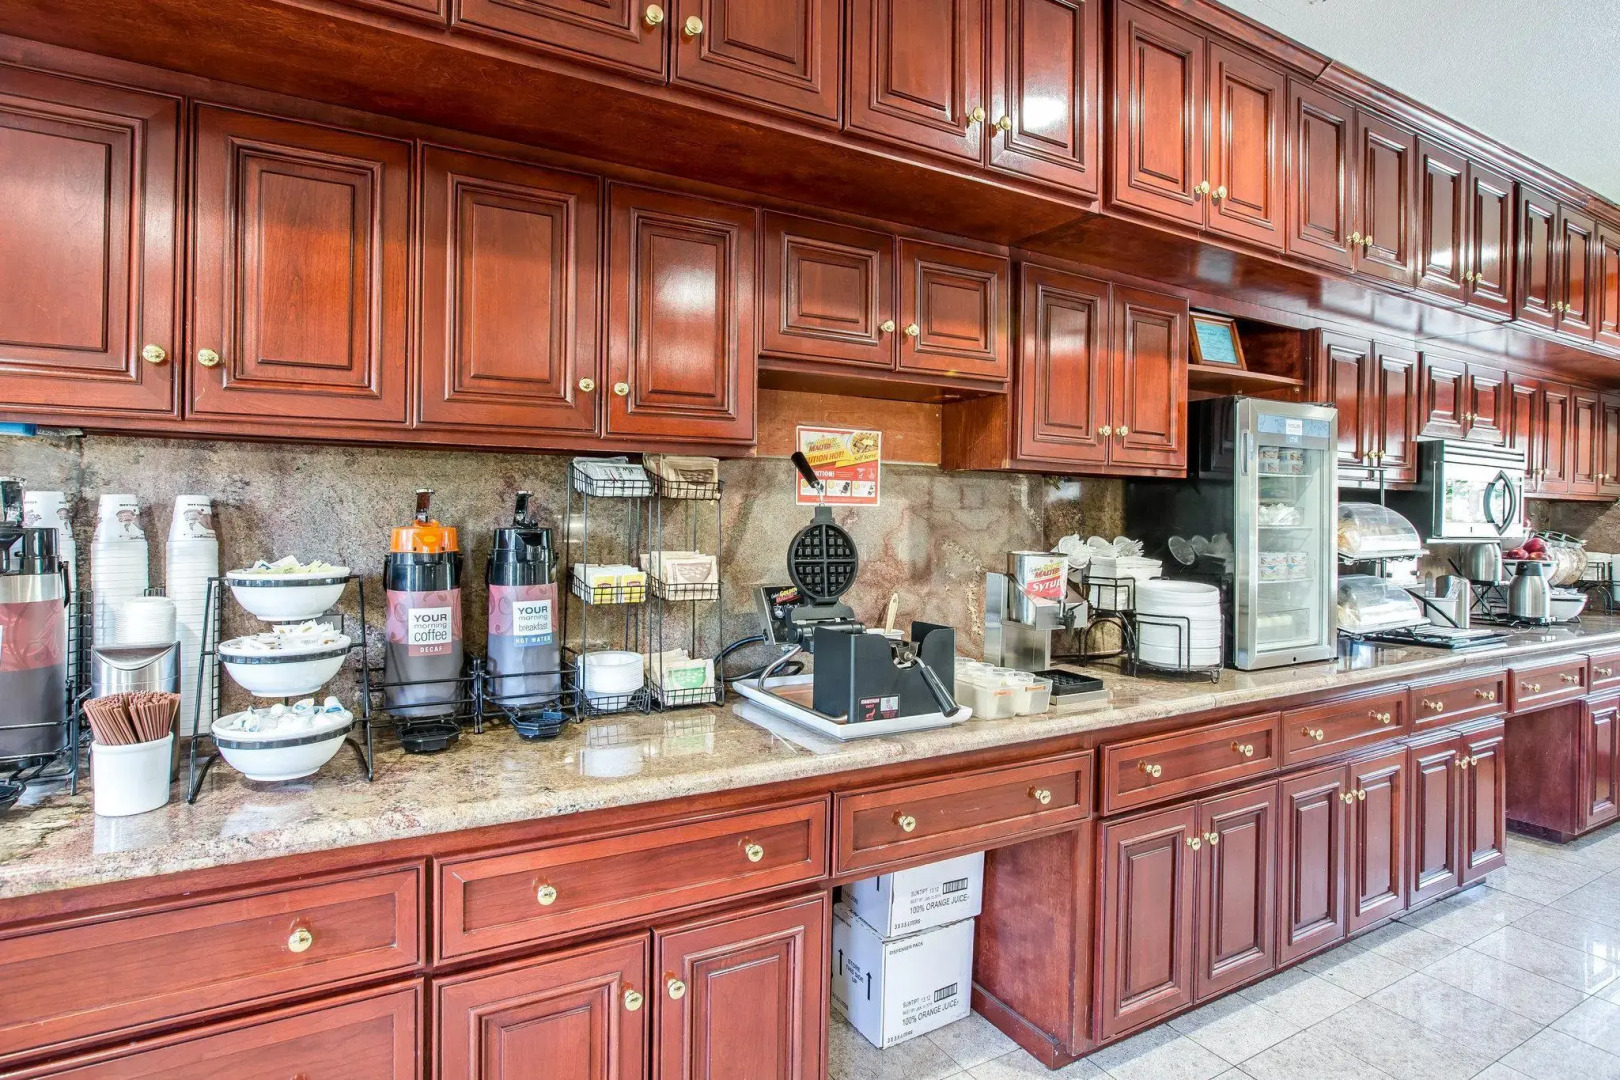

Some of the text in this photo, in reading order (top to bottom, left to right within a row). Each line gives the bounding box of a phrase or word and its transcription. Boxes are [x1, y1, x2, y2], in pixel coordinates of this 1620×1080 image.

[518, 605, 548, 615] YOUR
[414, 614, 447, 622] YOUR
[518, 622, 548, 632] breakfast
[414, 629, 447, 642] coffee
[910, 904, 925, 914] 100%
[926, 898, 950, 911] ORANGE
[903, 1015, 917, 1026] 100%
[917, 1005, 941, 1020] ORANGE
